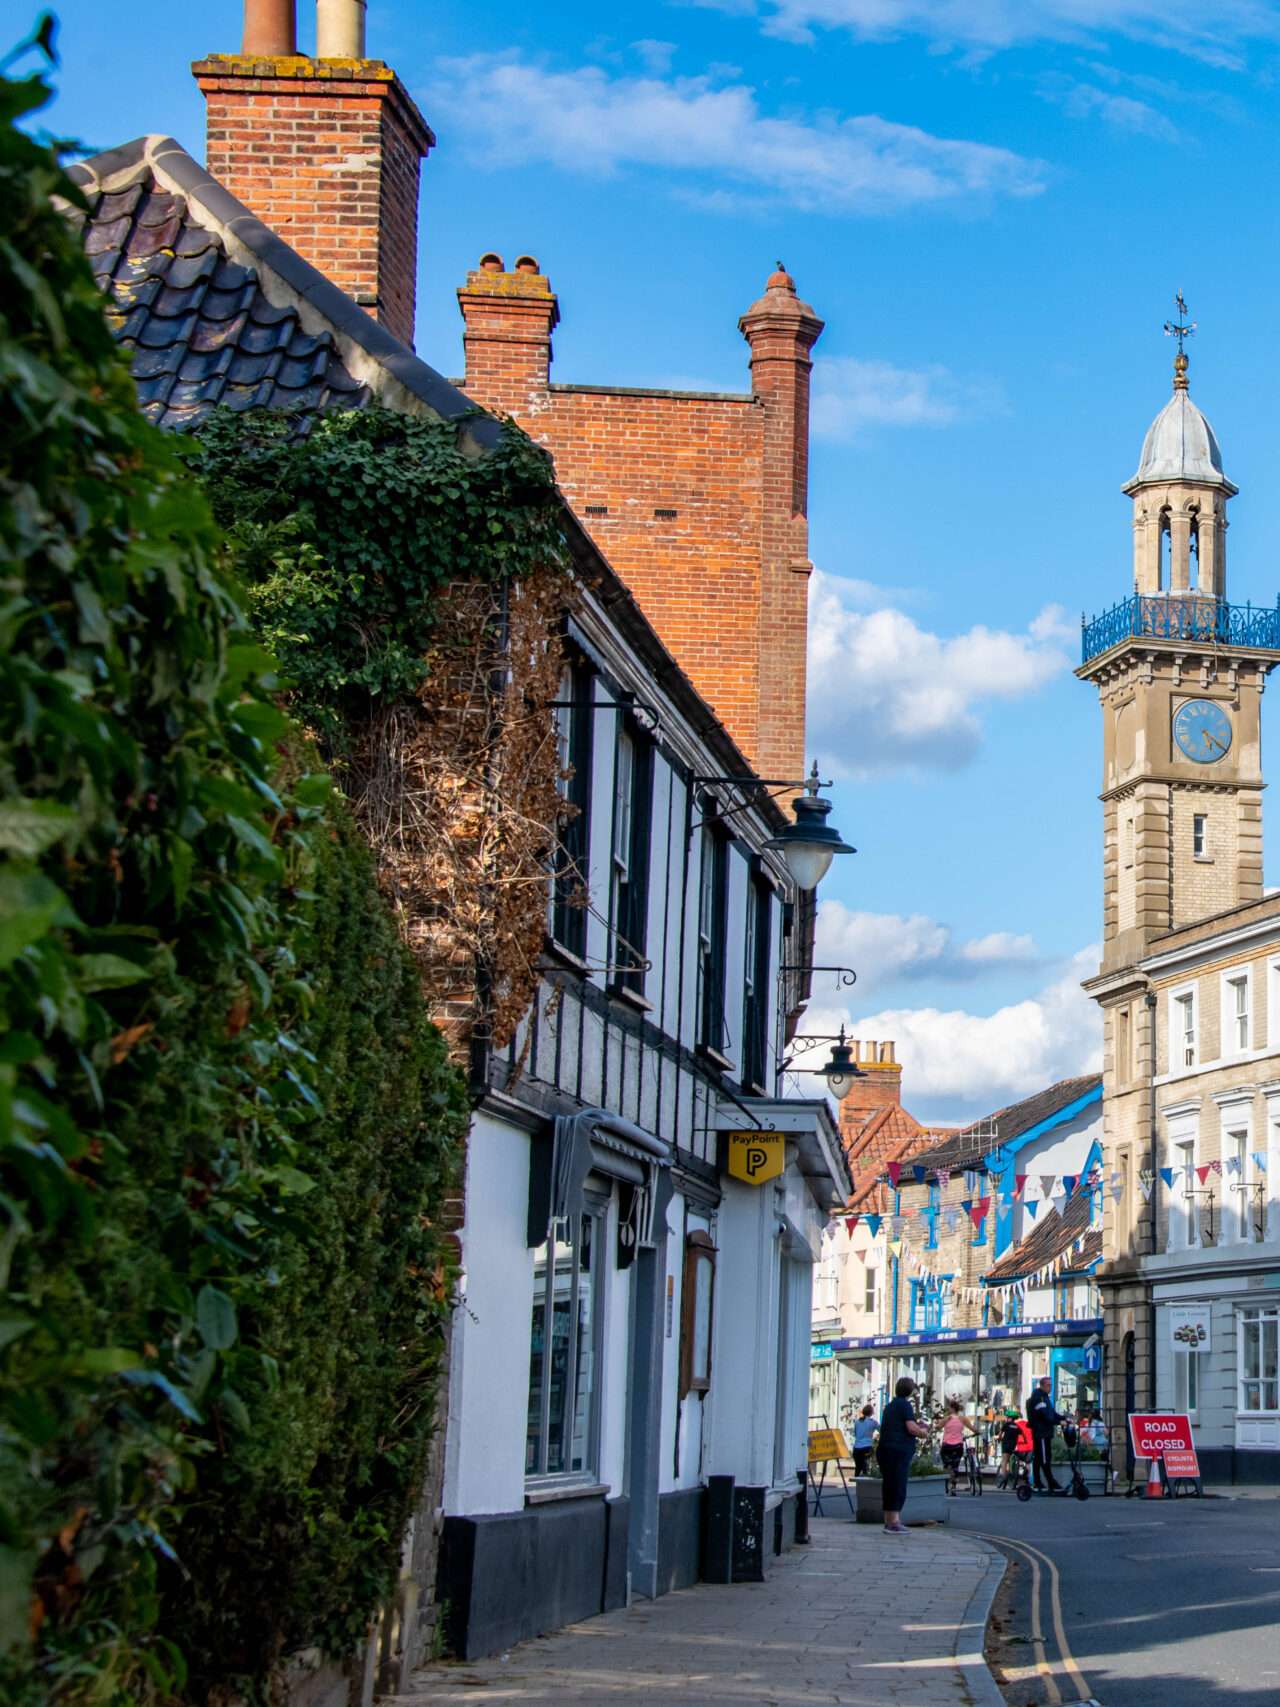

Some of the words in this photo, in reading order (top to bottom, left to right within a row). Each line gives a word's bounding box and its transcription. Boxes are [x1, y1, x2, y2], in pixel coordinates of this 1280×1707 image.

[732, 1134, 780, 1146] PayPoint
[1143, 1422, 1177, 1433] ROAD
[1141, 1440, 1186, 1450] CLOSED
